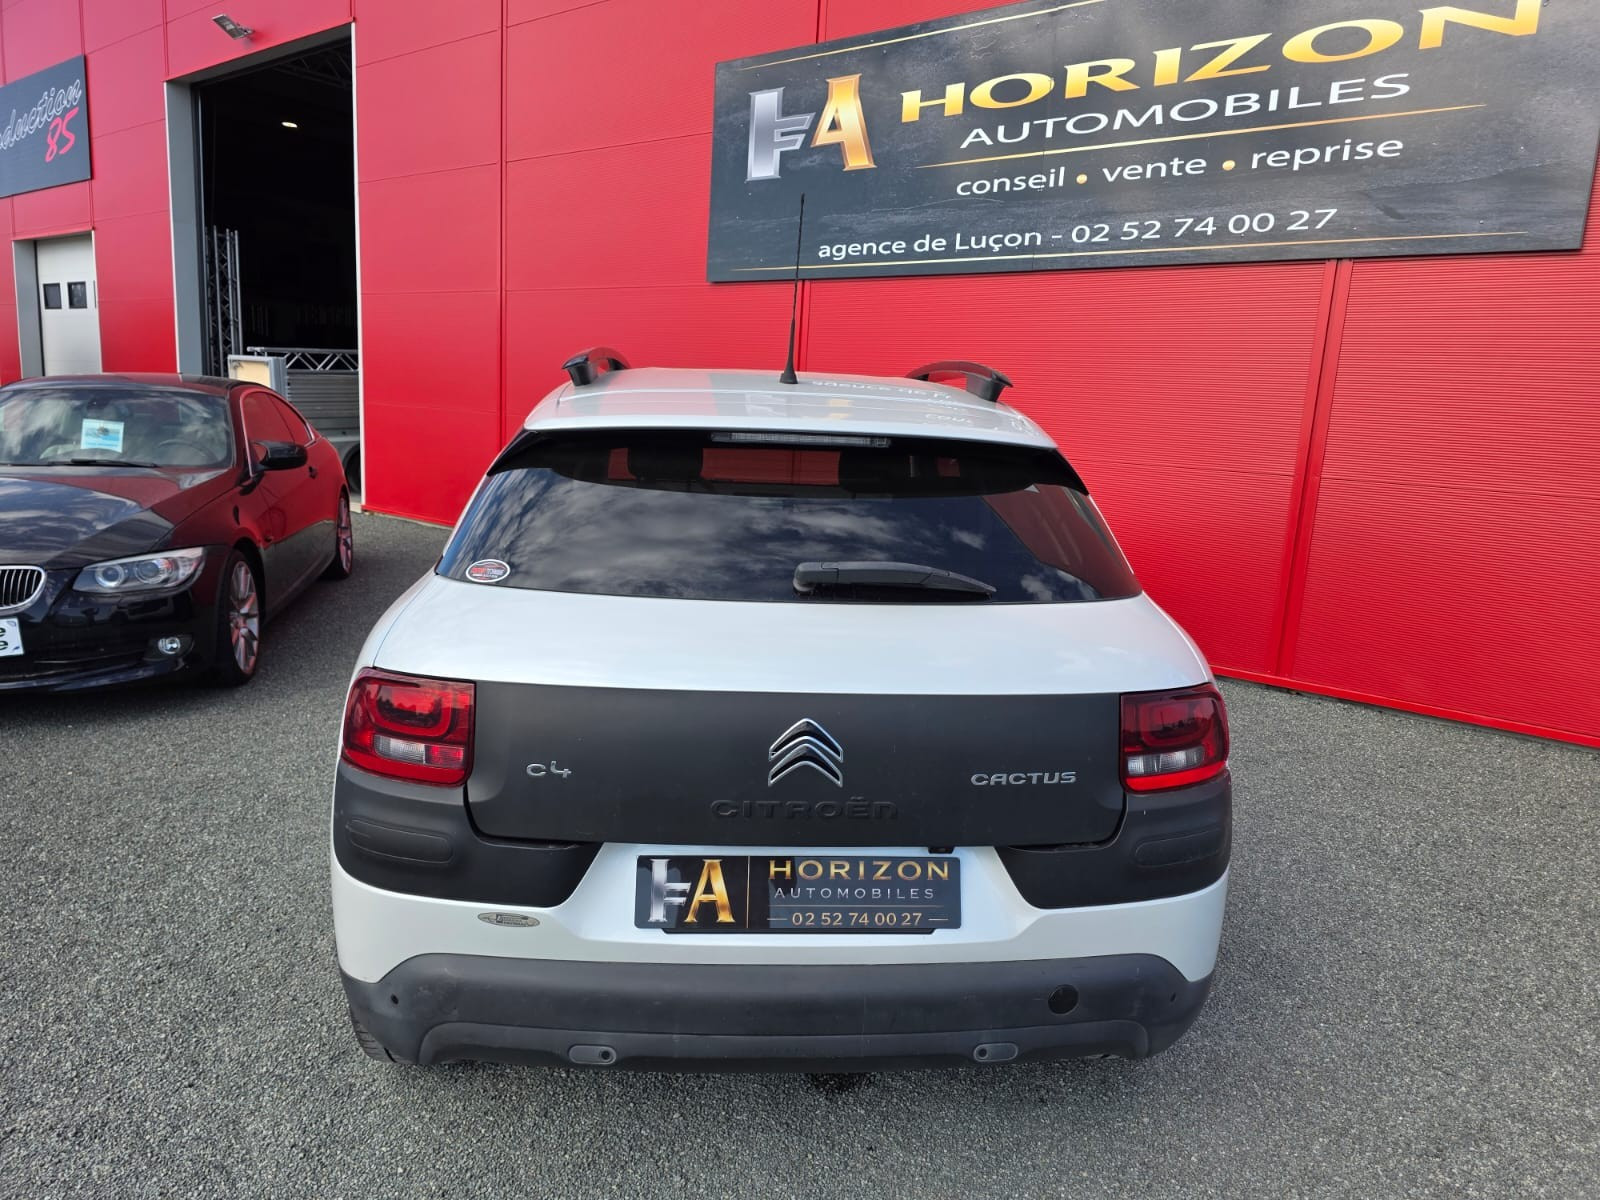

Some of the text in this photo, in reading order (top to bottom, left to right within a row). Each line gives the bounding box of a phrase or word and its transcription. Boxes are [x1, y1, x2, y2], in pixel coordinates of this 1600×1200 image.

[900, 0, 1543, 123] HORIZON
[960, 73, 1411, 148] AUTOMOBILES
[956, 139, 1404, 196] conseil vente reprise
[818, 239, 906, 261] agence
[913, 234, 947, 253] de
[955, 231, 1042, 252] Luçon
[1071, 224, 1110, 243] 02
[1120, 220, 1162, 241] 52
[1174, 216, 1217, 237] 74
[1228, 212, 1275, 234] 00
[1287, 208, 1338, 231] 27
[526, 760, 572, 778] C4
[970, 771, 1077, 786] CACTUS
[710, 796, 899, 820] CITROËN
[768, 860, 949, 881] HORIZON
[774, 887, 934, 899] AUTOMOBILES
[791, 912, 923, 926] 02 52 74 00 27
